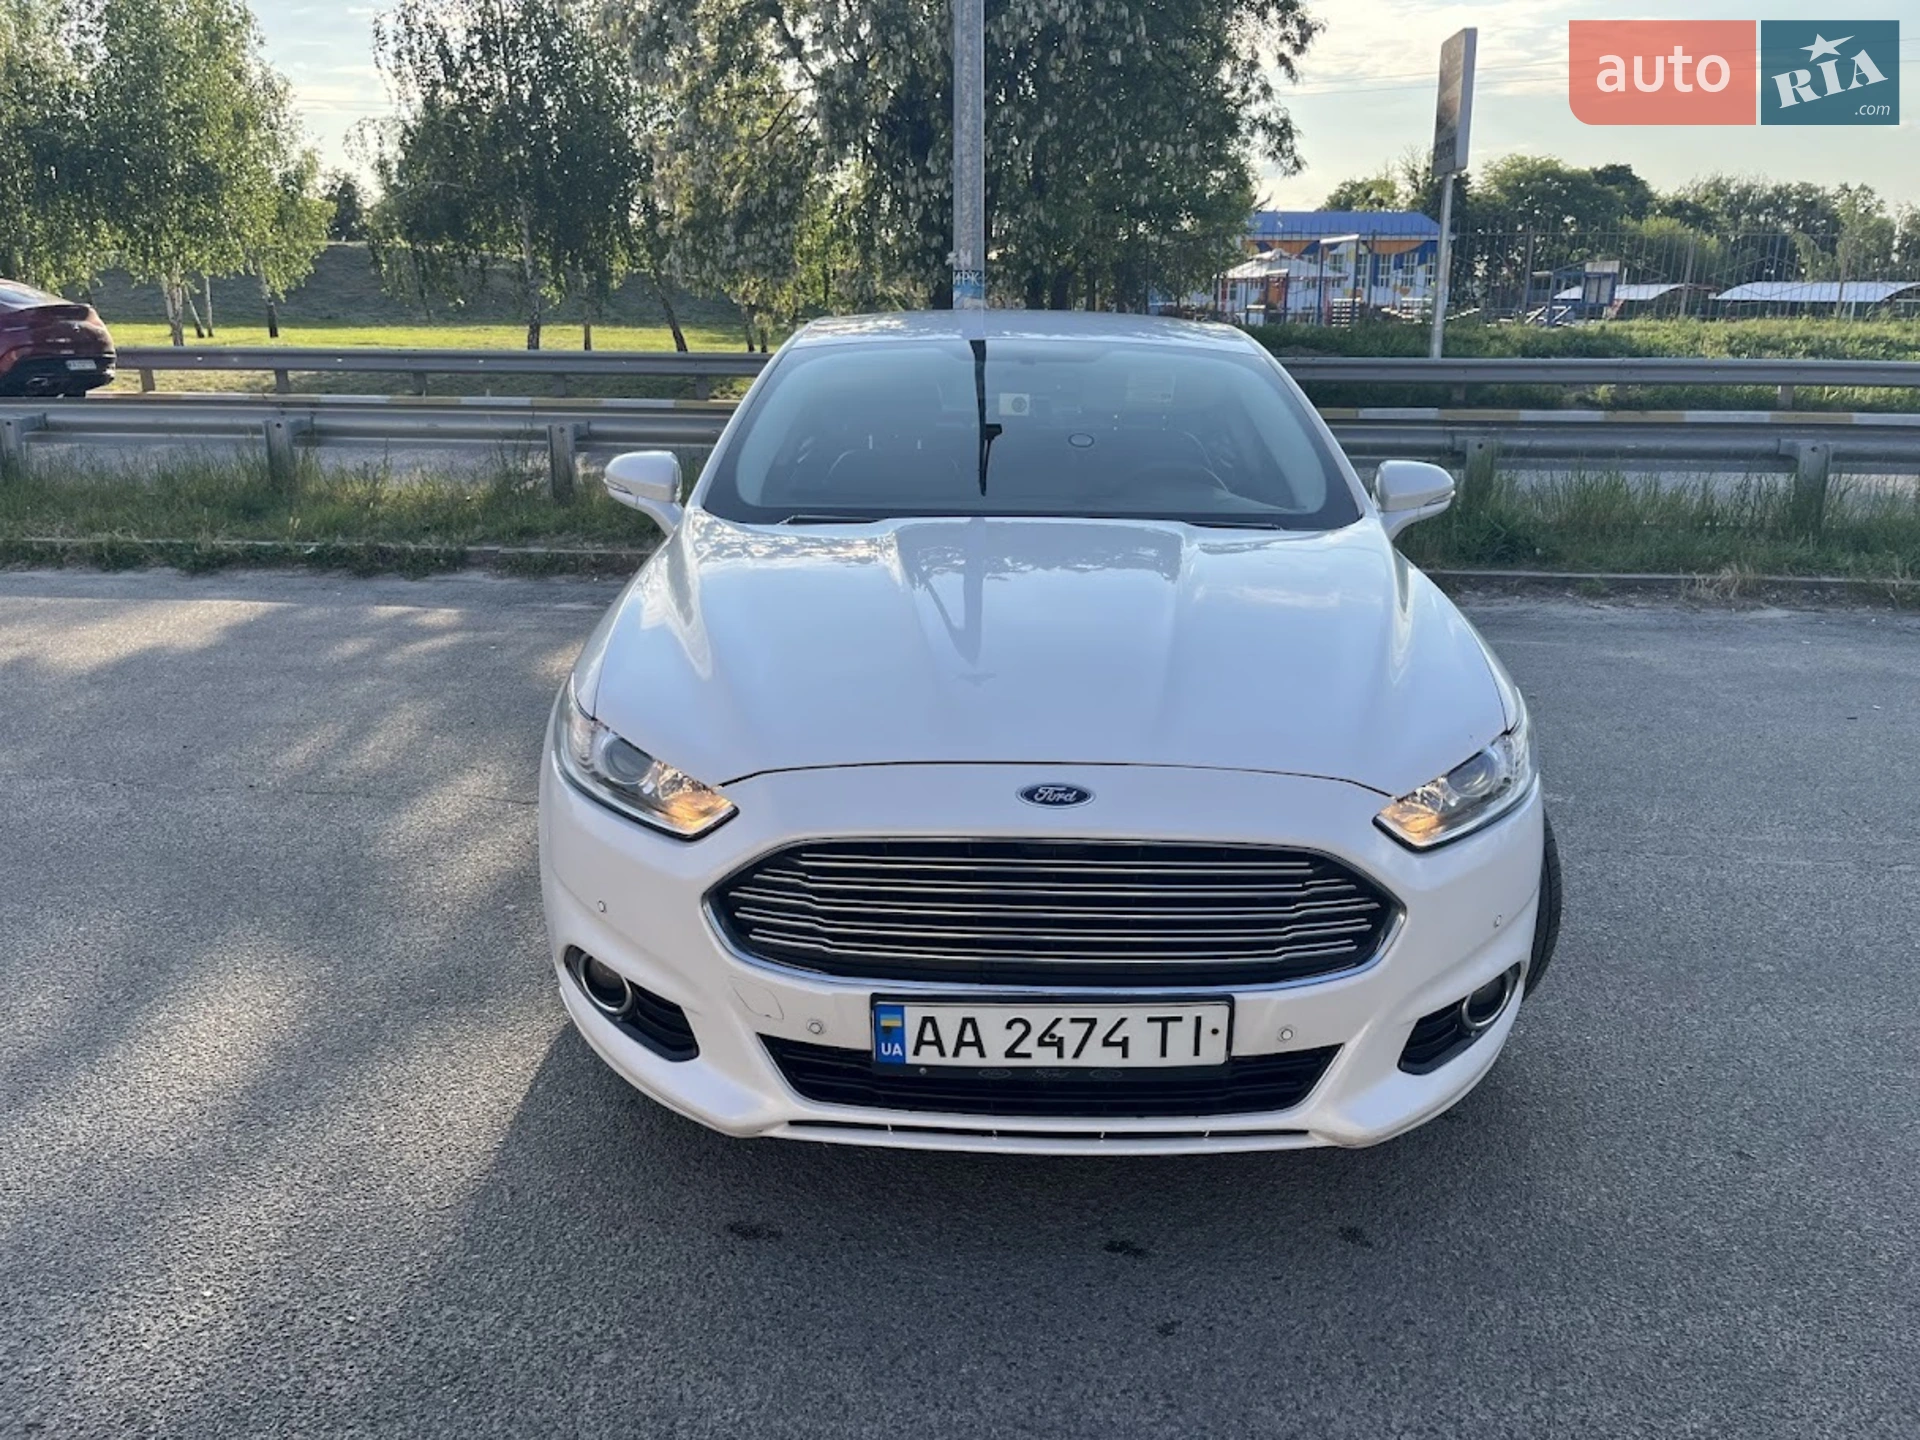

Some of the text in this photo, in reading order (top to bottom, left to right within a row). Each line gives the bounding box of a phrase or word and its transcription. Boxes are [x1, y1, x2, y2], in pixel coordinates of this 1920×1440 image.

[1033, 786, 1077, 803] Ford
[912, 1015, 1202, 1059] AA 2474 TI
[881, 1042, 903, 1056] UA
